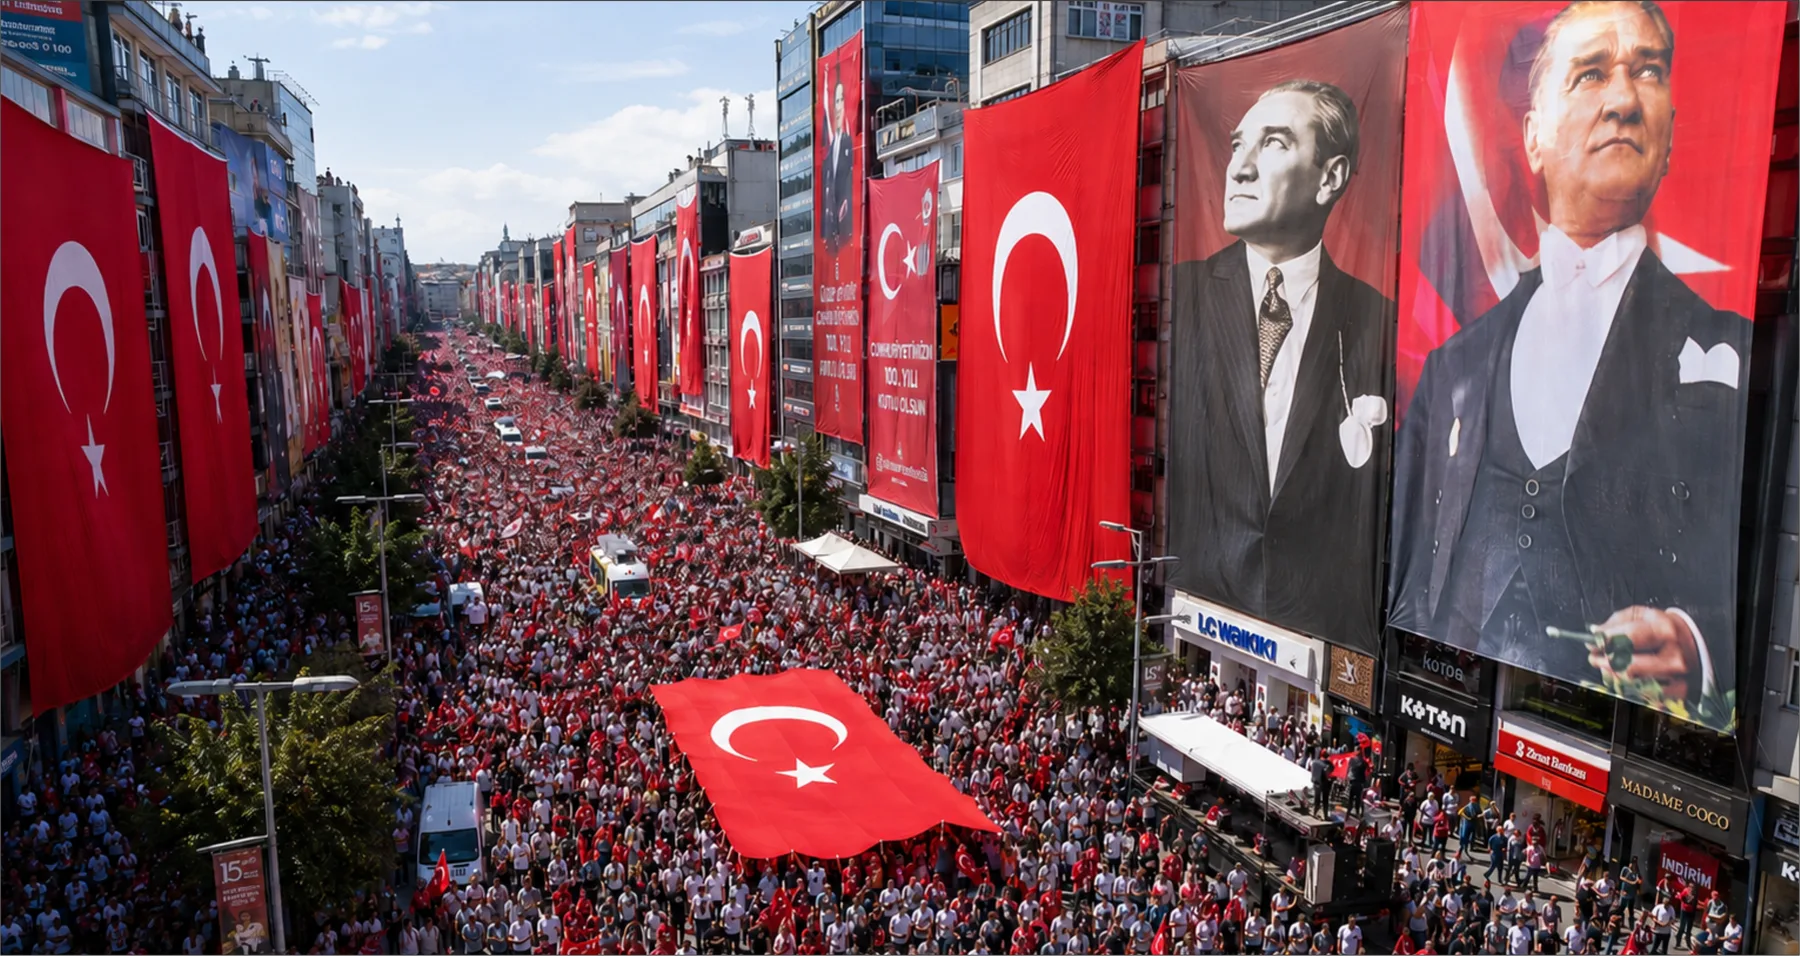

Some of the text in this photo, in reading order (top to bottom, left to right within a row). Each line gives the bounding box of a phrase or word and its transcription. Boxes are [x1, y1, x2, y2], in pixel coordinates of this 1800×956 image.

[1620, 776, 1730, 831] MADAME COCO
[220, 860, 243, 884] 15
